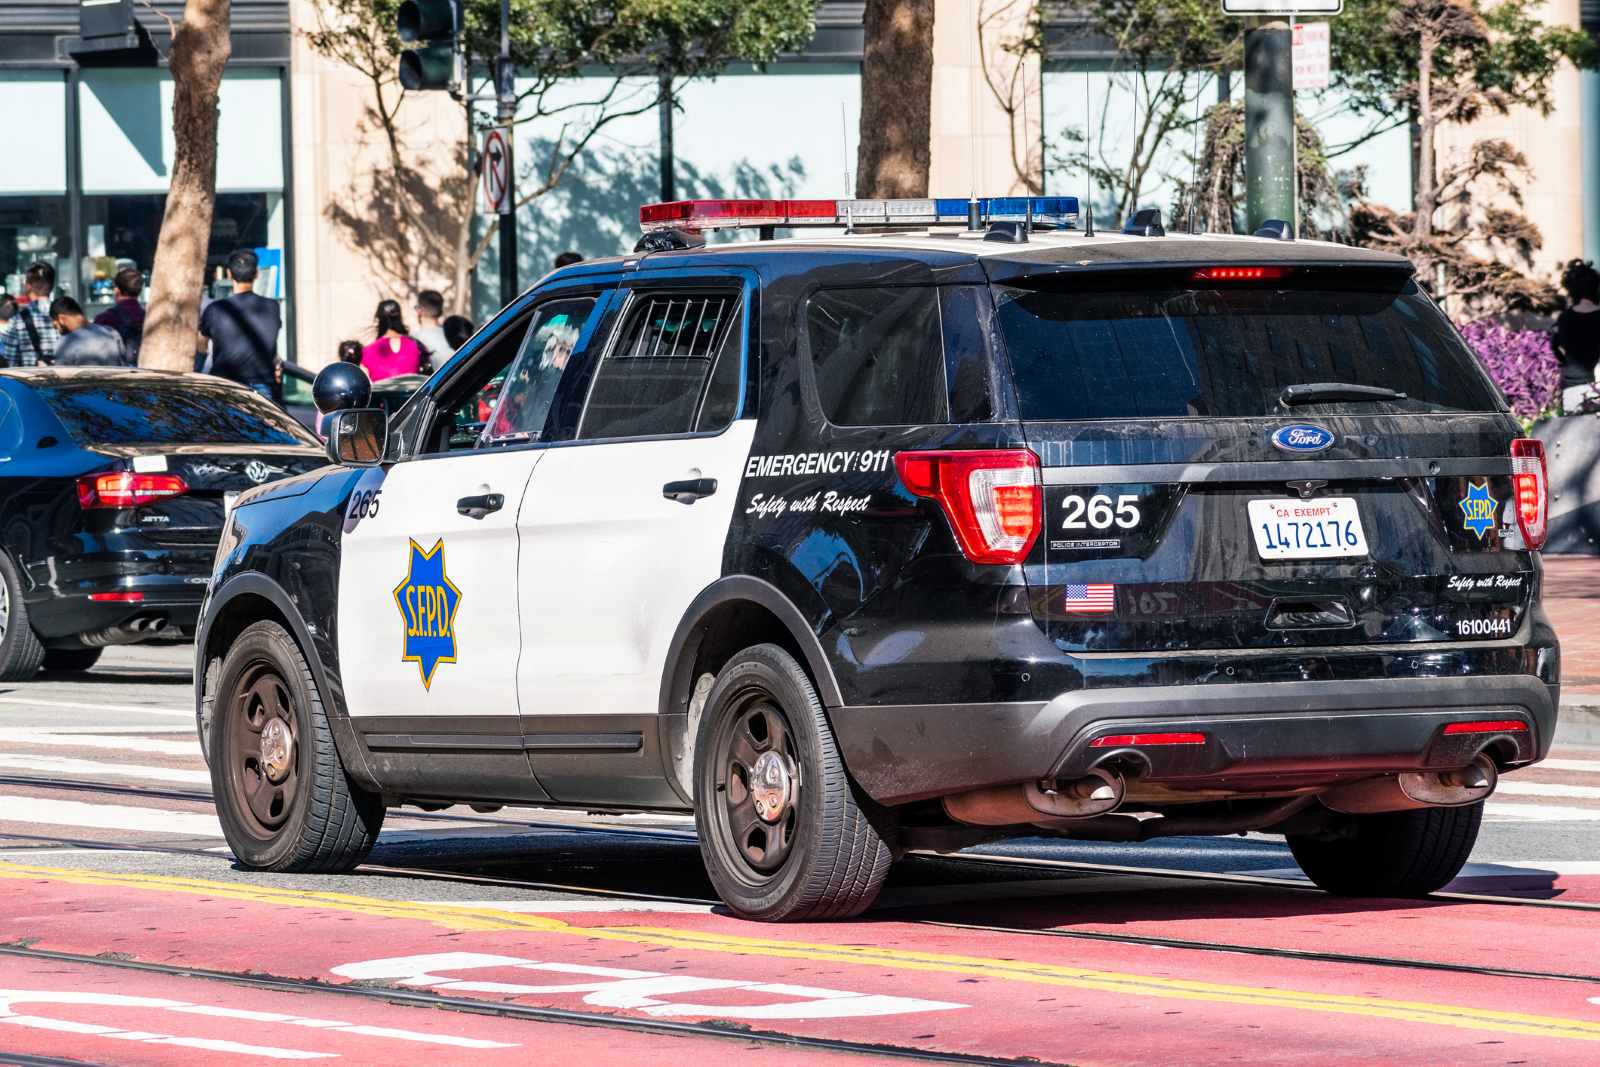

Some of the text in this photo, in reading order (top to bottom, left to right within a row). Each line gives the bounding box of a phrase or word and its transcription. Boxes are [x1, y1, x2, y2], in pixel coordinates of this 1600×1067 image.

[1288, 429, 1321, 445] Ford
[745, 449, 890, 478] EMERGENCY 911
[348, 490, 382, 520] 265
[745, 490, 872, 519] Safety with Respect
[1061, 494, 1141, 529] 265
[1276, 507, 1331, 518] CA EXEMPT
[142, 515, 170, 523] JETTA
[1262, 521, 1358, 549] 1472176
[1447, 574, 1522, 592] Safety with Respect
[405, 584, 451, 638] S.F.P.D.
[1456, 619, 1511, 635] 16100441
